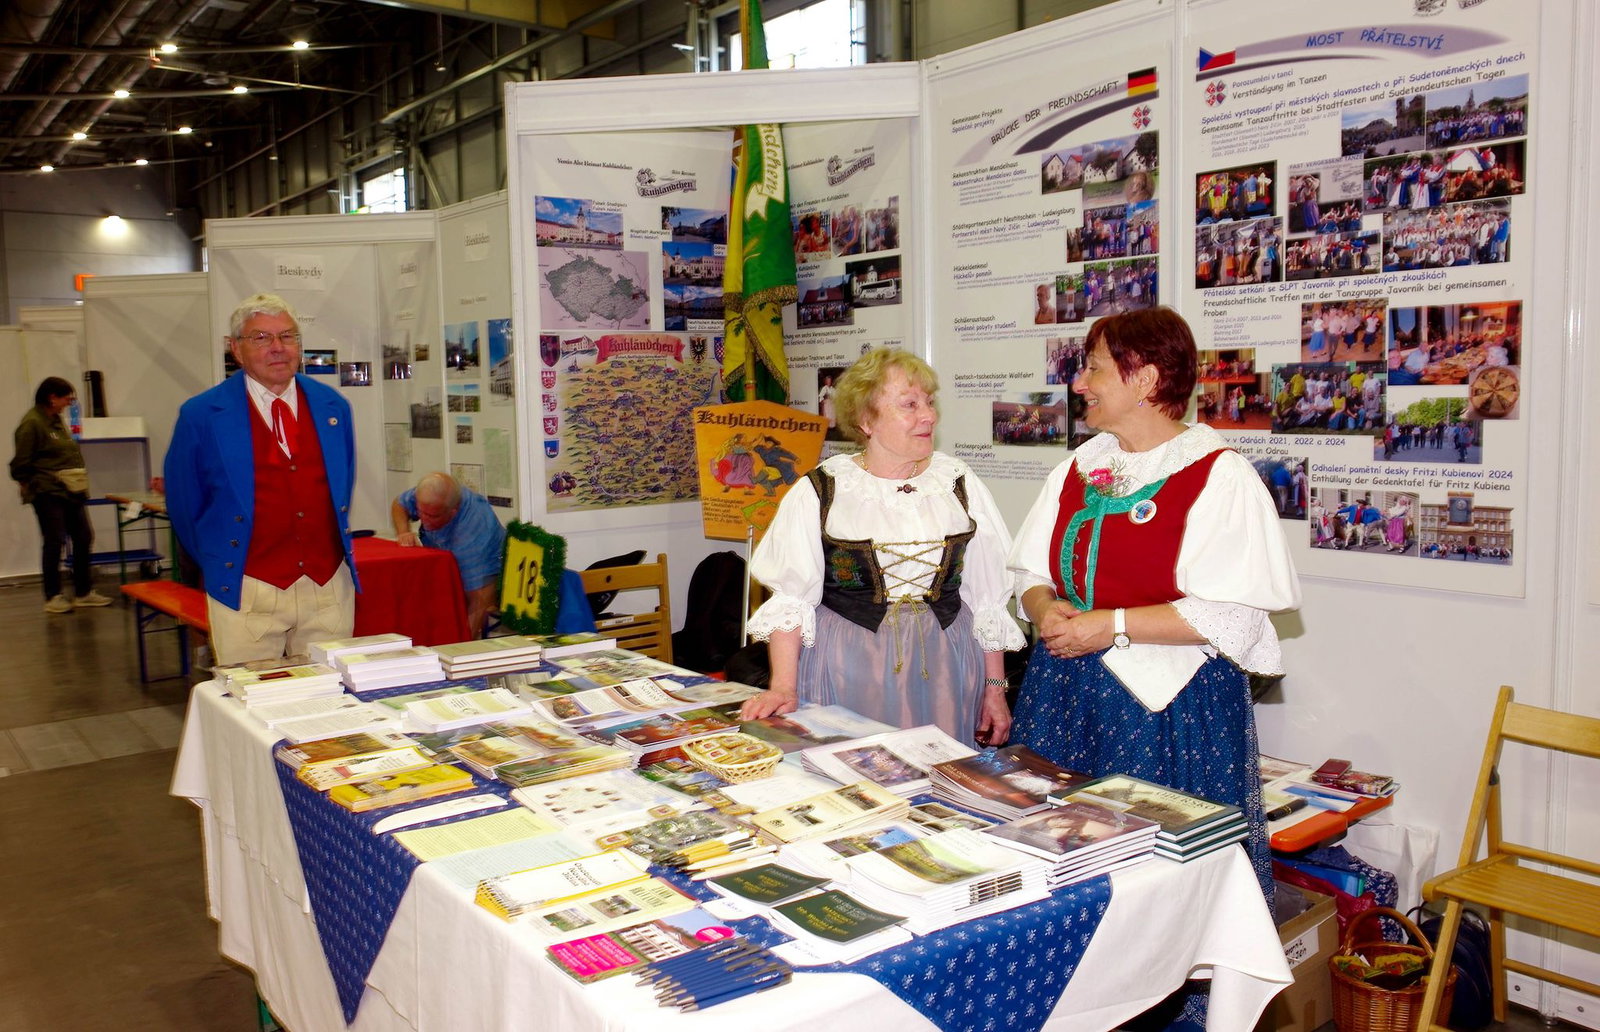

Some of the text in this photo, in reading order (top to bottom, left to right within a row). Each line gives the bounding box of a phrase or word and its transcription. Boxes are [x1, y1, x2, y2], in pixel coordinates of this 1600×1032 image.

[1306, 31, 1344, 47] MOST
[1277, 69, 1294, 79] tanci
[1287, 80, 1296, 88] im
[1299, 74, 1328, 85] Tanzen
[1333, 81, 1381, 98] slavnostech
[1384, 80, 1390, 88] a
[1496, 52, 1526, 65] dnech
[1201, 119, 1244, 134] Gemeinsame
[1246, 110, 1298, 125] Tanzauftritte
[1300, 104, 1314, 115] bei
[1316, 96, 1367, 112] Stadtfesten
[1369, 92, 1385, 102] und
[1388, 75, 1472, 98] Sudetendeutschen
[1476, 69, 1506, 82] Tagen
[990, 80, 1119, 146] BRÜCKE DER FREUNDSCHAFT
[277, 264, 323, 279] Beskydy
[1279, 283, 1299, 292] SLPT
[1353, 274, 1398, 287] společných
[1402, 270, 1447, 281] zkouškách
[1203, 295, 1267, 307] Freundschaftliche
[1270, 292, 1300, 302] Treffen
[1303, 291, 1316, 300] mit
[1319, 290, 1333, 299] der
[1336, 287, 1383, 298] Tanzgruppe
[1428, 282, 1442, 291] bei
[1445, 279, 1507, 292] gemeinsamen
[1203, 309, 1228, 318] Proben
[697, 410, 823, 432] Kuhländchen
[1239, 436, 1266, 445] Odrách
[1269, 437, 1291, 446] 2021,
[1294, 437, 1314, 446] 2022
[1325, 438, 1346, 446] 2024
[1265, 447, 1289, 455] Odrau
[1311, 464, 1513, 479] Odhalení pamětní desky Fritzi Kubienovi 2024
[1311, 474, 1511, 491] Enthüllung der Gedenktafel für Fritz Kubiena
[518, 555, 538, 604] 18
